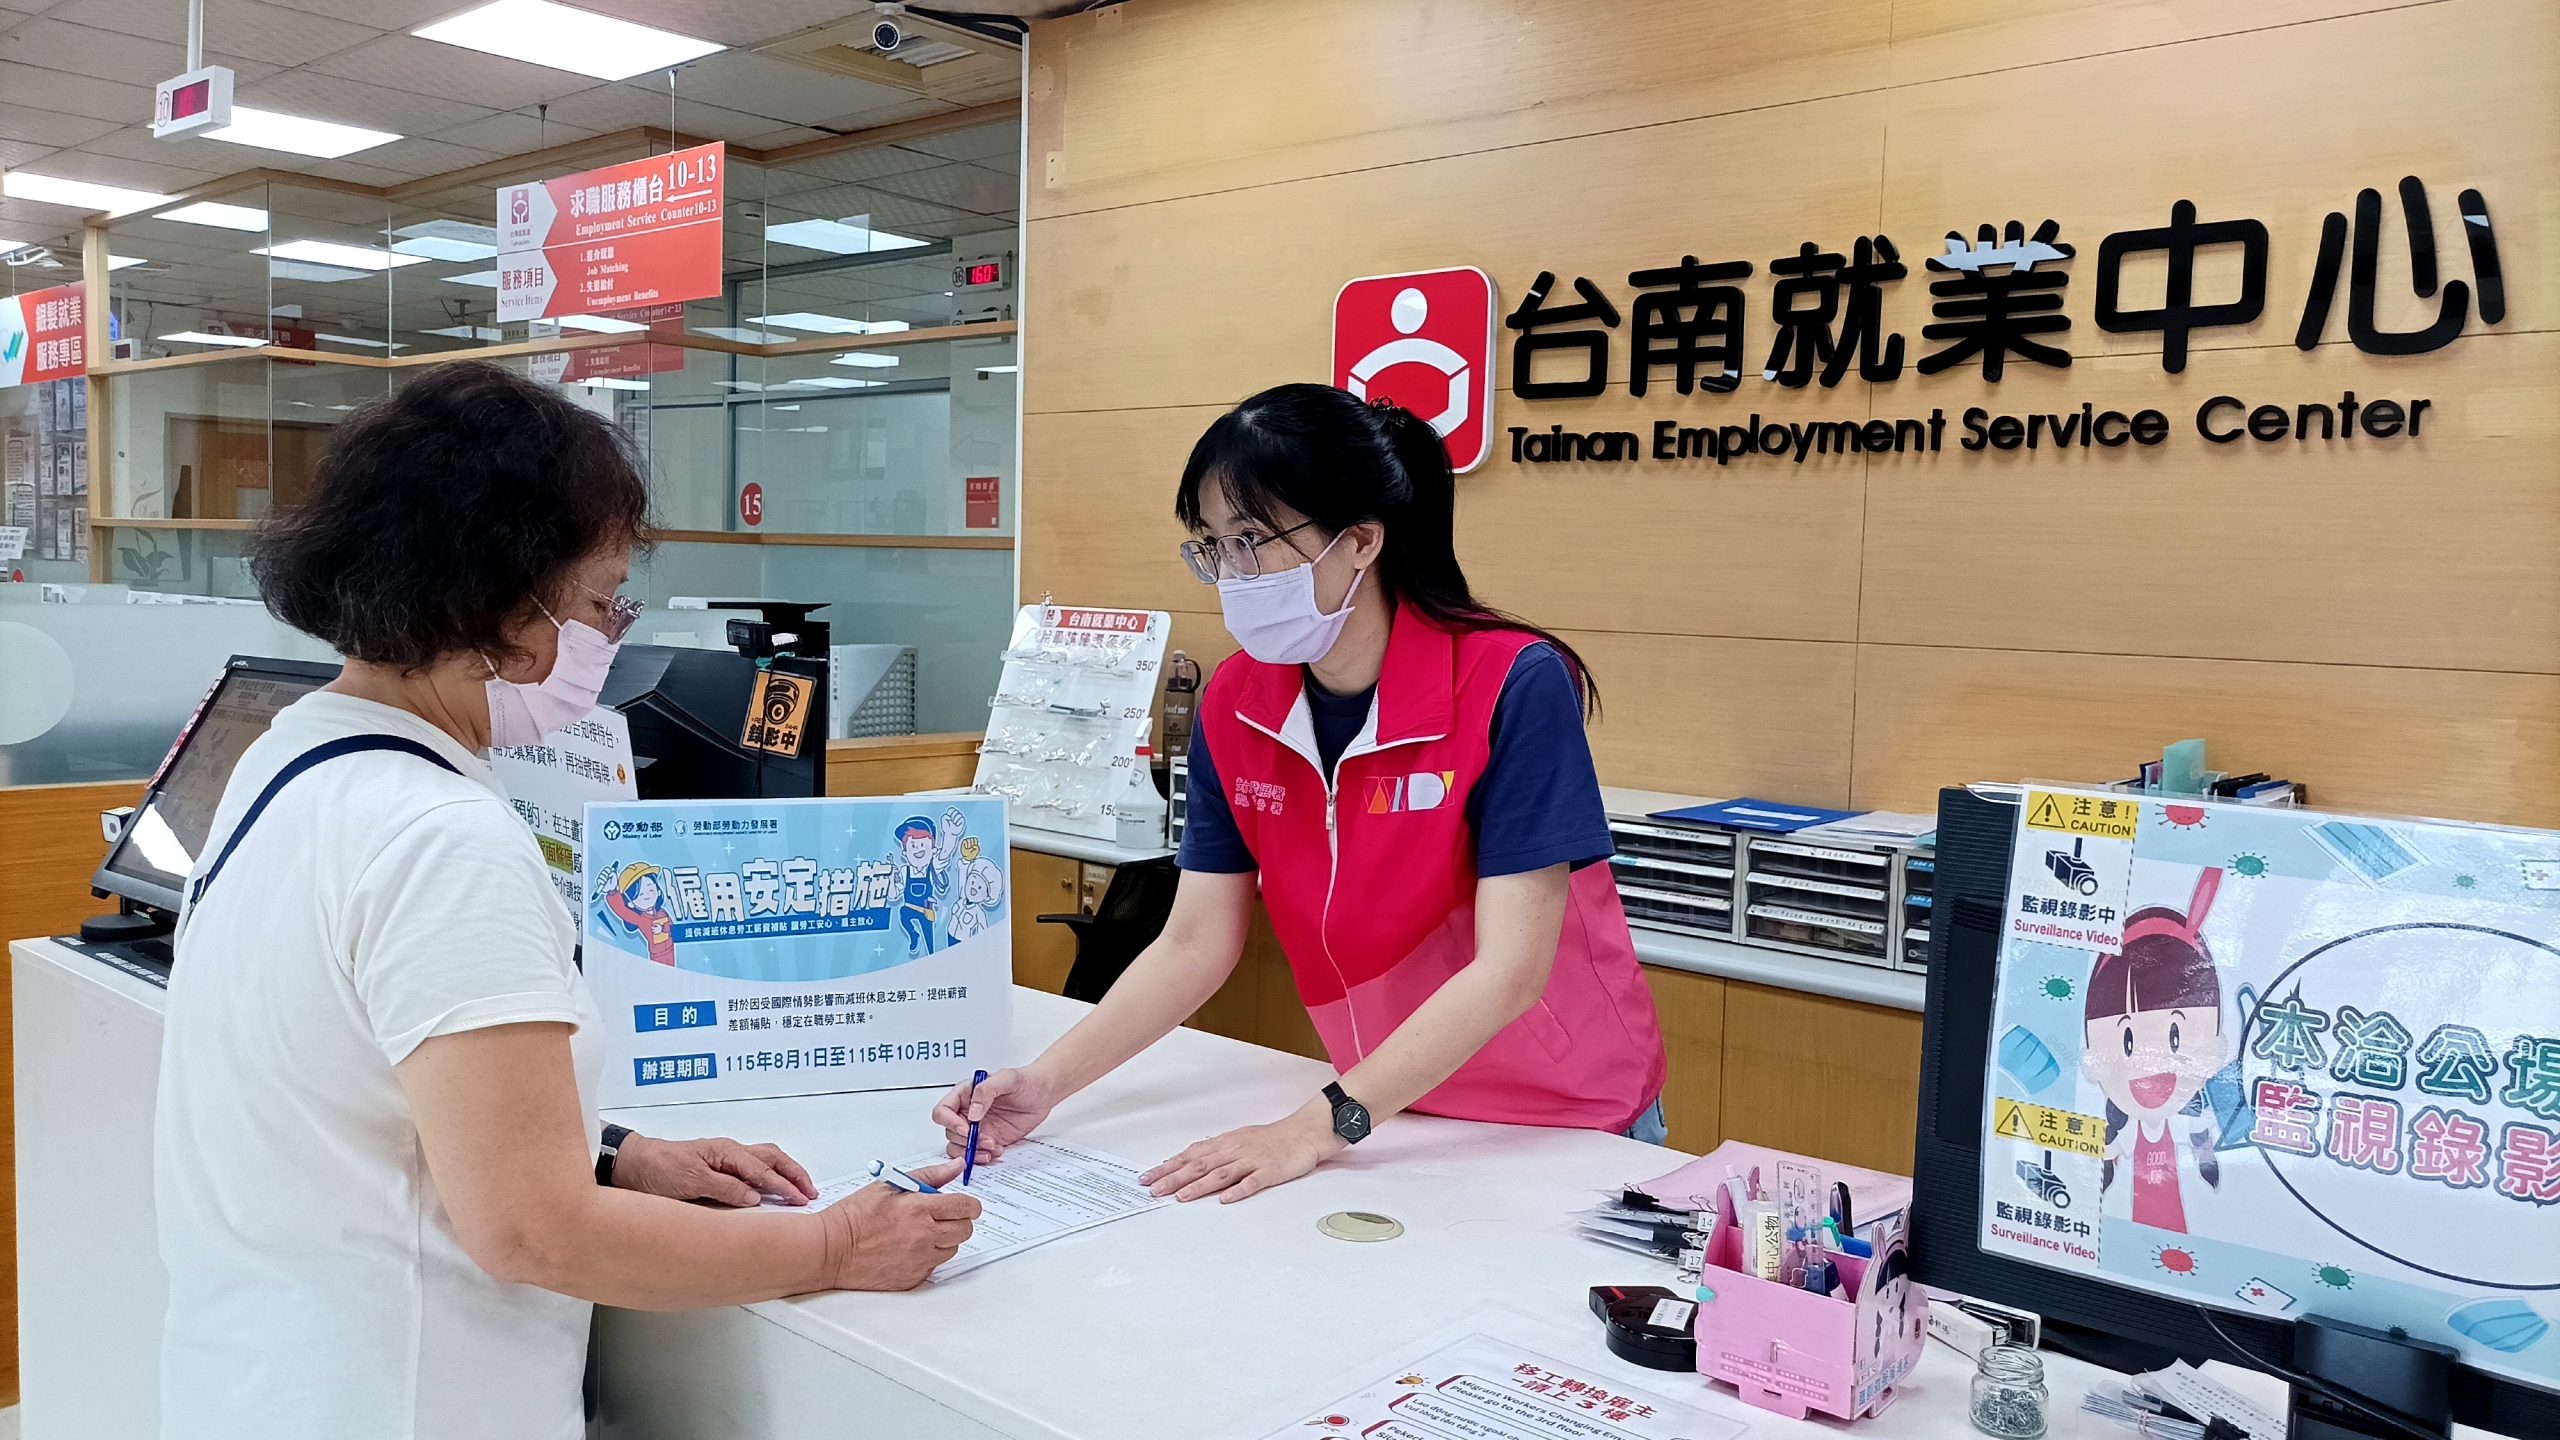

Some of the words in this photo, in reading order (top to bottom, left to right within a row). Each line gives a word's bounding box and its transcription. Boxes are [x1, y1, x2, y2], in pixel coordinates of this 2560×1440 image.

[570, 174, 664, 218] 求職服務櫃台
[667, 154, 717, 191] 10-13
[575, 219, 624, 238] Employment
[627, 211, 657, 228] Service
[660, 199, 717, 221] Counter10-13
[502, 267, 544, 291] 服務項目
[586, 266, 598, 276] Job
[600, 262, 629, 274] Matching
[954, 270, 964, 284] 16
[586, 293, 632, 307] Unemployment
[633, 288, 659, 301] Benefits
[1506, 175, 2506, 399] 台南就業中心
[501, 296, 524, 307] Service
[525, 294, 543, 304] Items
[35, 296, 82, 333] 銀髮就業
[36, 335, 82, 372] 服務專區
[1507, 424, 1639, 463] Tainan
[1652, 408, 1946, 466] Employment
[1960, 402, 2169, 452] Service
[2195, 390, 2431, 444] Center
[743, 494, 761, 516] 15
[1068, 612, 1139, 631] 台南就業中心
[1136, 660, 1158, 672] 350°
[1123, 707, 1146, 720] 250°
[746, 723, 797, 751] 錄影中
[1111, 756, 1134, 769] 200°
[621, 821, 663, 833] 勞動部
[693, 819, 778, 831] 勞動部勞動力發展署
[2070, 819, 2131, 836] CAUTION
[662, 856, 893, 923] 僱用安定措施
[2020, 894, 2116, 925] 監視錄影中
[685, 922, 788, 938] 提供減班休息勞工薪資補貼
[790, 916, 874, 931] 讓勞工安心、雇主放心
[2014, 918, 2083, 941] Surveillance
[2086, 929, 2118, 946] Video
[727, 986, 968, 1012] 對於因受國際情勢影響而減班休息之勞工，提供薪資
[653, 1005, 698, 1027] 目的
[727, 1012, 876, 1032] 差額補貼，穩定在職勞工就業。
[725, 1038, 967, 1072] 115年8月1日至115年10月31日
[641, 1056, 710, 1081] 辦理期間
[2038, 1132, 2099, 1155] CAUTION
[2146, 1150, 2167, 1166] GOOD
[2147, 1169, 2162, 1185] JOB
[1701, 1218, 1713, 1227] 14
[1996, 1200, 2091, 1239] 監視錄影中
[1990, 1223, 2060, 1251] Surveillance
[2063, 1240, 2096, 1260] Video
[1689, 1255, 1701, 1265] 17
[1512, 1361, 1658, 1420] 移工轉換雇主
[1412, 1398, 1429, 1410] Lao
[1449, 1384, 1483, 1402] Please
[1481, 1396, 1499, 1408] go
[1500, 1402, 1514, 1413] to
[1514, 1404, 1533, 1418] the
[1535, 1414, 1555, 1428] 3rd
[1556, 1421, 1585, 1438] floor
[1458, 1379, 1502, 1400] Migrant
[1502, 1393, 1548, 1415] Workers
[1548, 1410, 1602, 1437] Changing
[1477, 1430, 1487, 1438] 3
